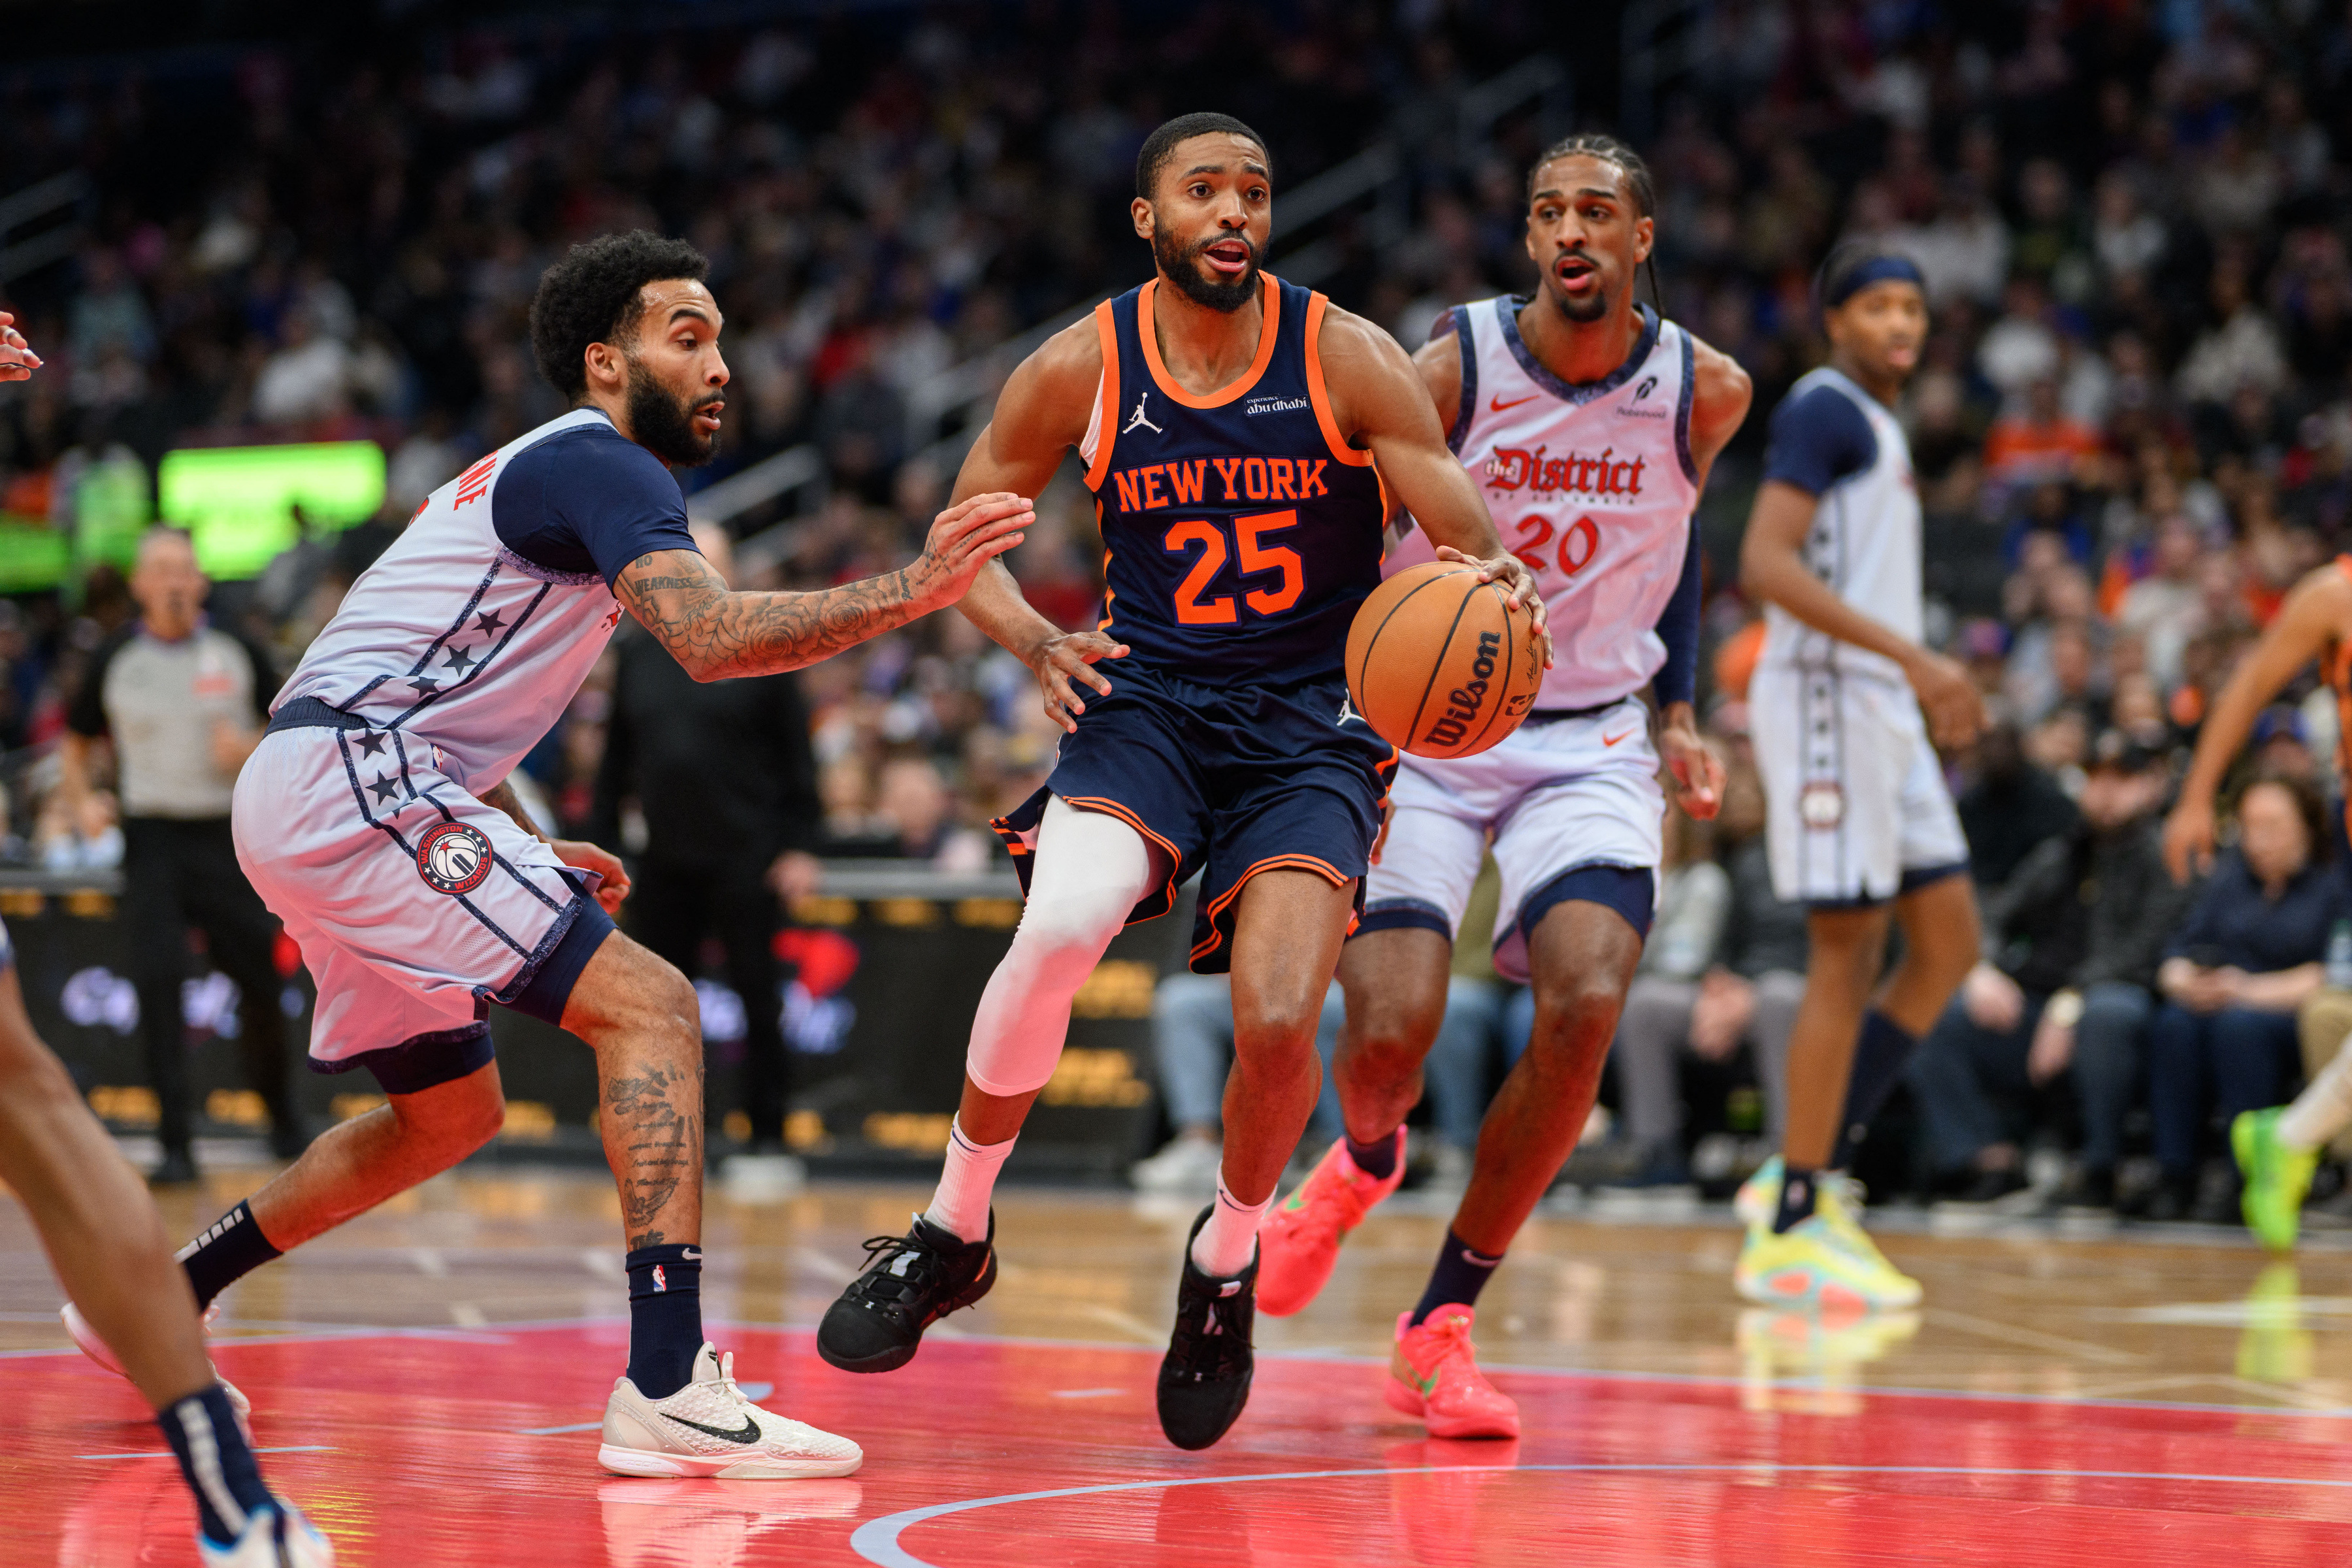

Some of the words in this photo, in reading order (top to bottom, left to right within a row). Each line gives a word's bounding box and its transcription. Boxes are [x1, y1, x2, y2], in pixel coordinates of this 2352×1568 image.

[1247, 403, 1271, 414] abu
[1272, 397, 1307, 411] dhabi
[1113, 459, 1207, 513] NEW
[1213, 457, 1328, 500] YORK
[1486, 444, 1645, 495] District
[636, 555, 653, 568] NO
[1164, 508, 1305, 625] 25
[1511, 514, 1599, 577] 20
[634, 576, 693, 595] WEAKNESS
[1423, 630, 1501, 747] Wilson
[421, 825, 463, 865] WASHINGTON
[454, 857, 488, 890] WIZARDS
